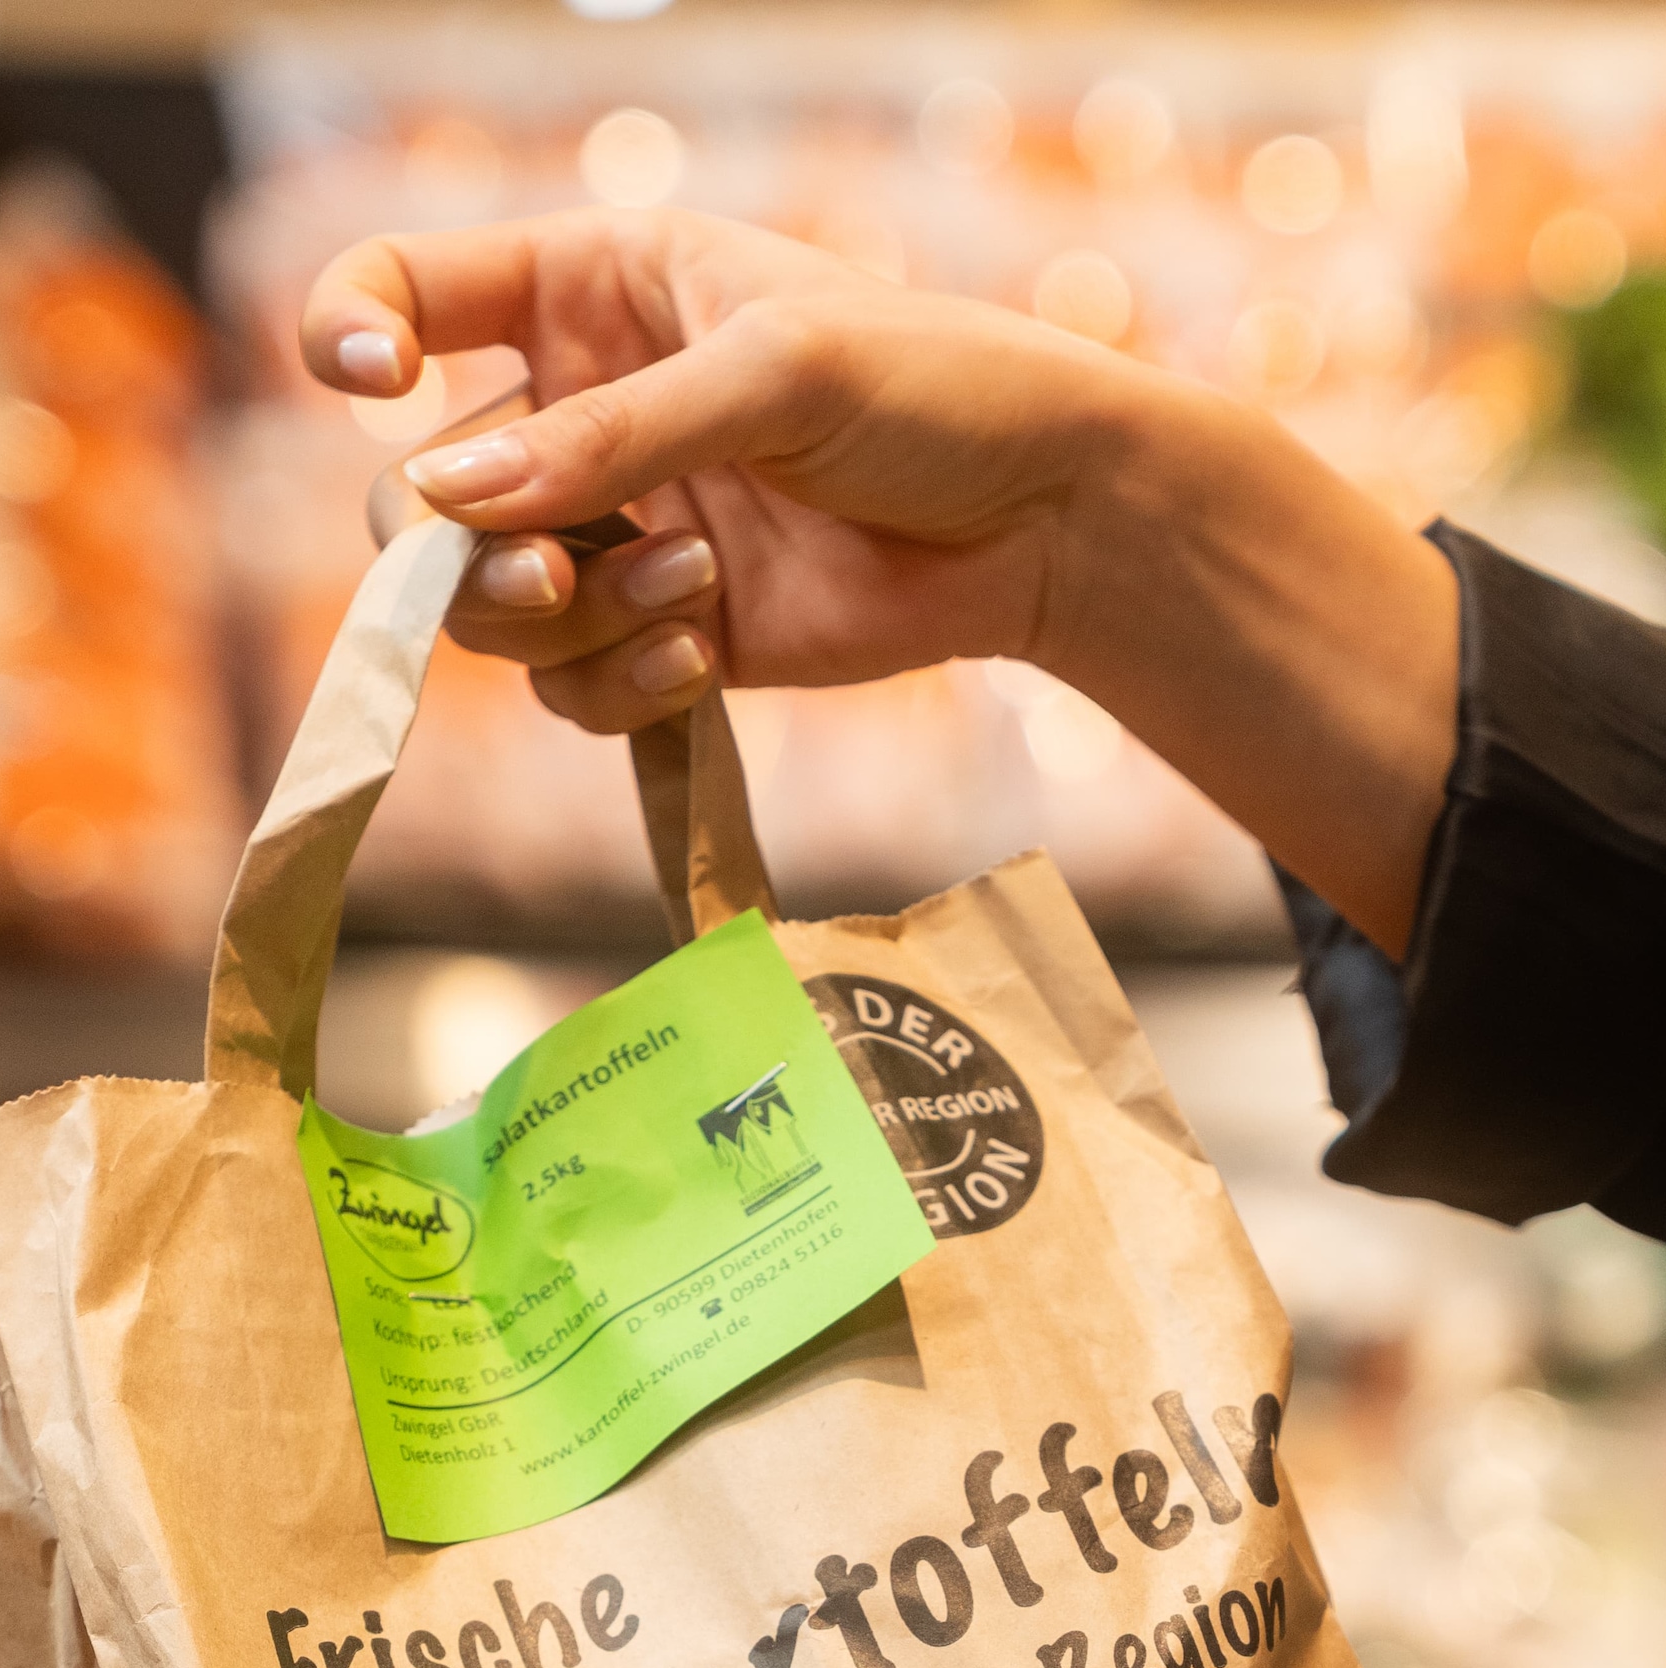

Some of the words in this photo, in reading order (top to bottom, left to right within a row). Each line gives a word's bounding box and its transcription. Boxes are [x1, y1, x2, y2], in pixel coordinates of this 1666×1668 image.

[852, 987, 975, 1069] DER
[897, 1085, 1021, 1121] REGION
[521, 1154, 586, 1202] 2,5kg
[917, 1137, 1031, 1226] GION
[652, 1274, 716, 1319] 90599
[718, 1196, 840, 1282] Dietenhofen
[728, 1257, 792, 1305] 09824
[794, 1222, 844, 1264] 5116
[380, 1366, 477, 1395] Ursprung:
[479, 1288, 610, 1387] Deutschland
[452, 1262, 577, 1347] festkochend
[390, 1413, 456, 1440] Zwingel
[458, 1411, 504, 1434] GbR
[518, 1311, 752, 1477] www.kartoffel-zwingel.de
[398, 1441, 498, 1465] Dietenholz
